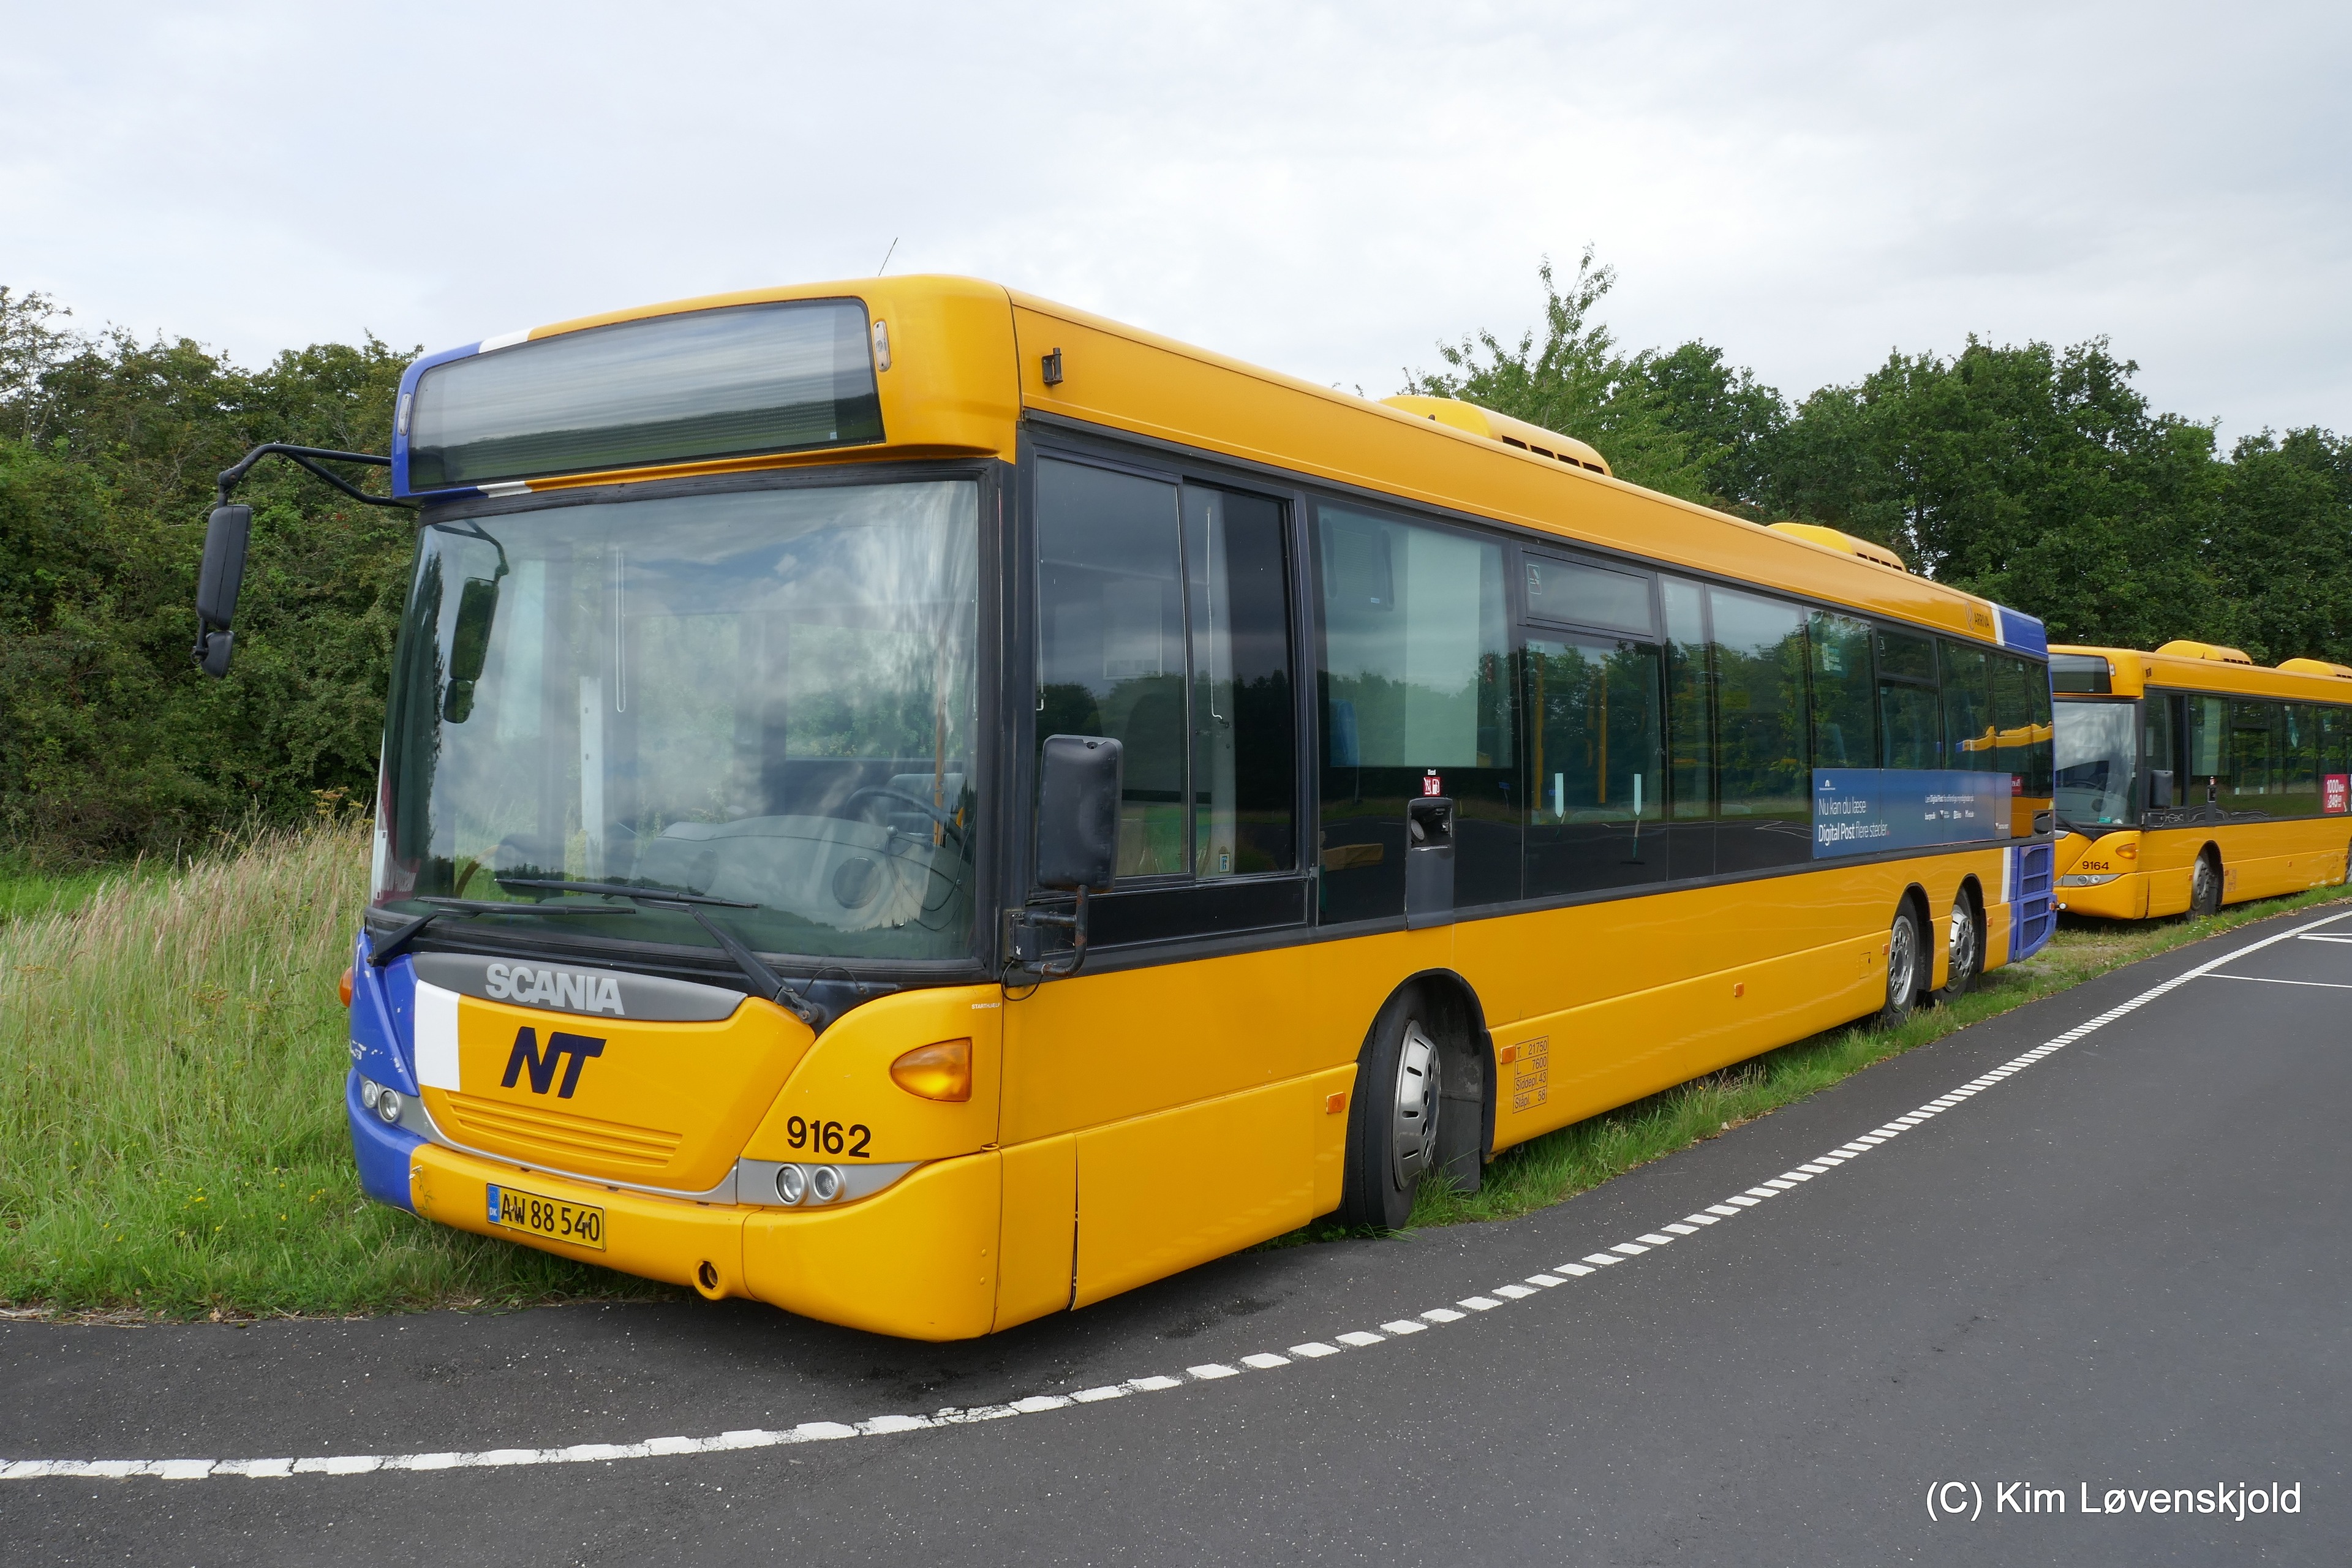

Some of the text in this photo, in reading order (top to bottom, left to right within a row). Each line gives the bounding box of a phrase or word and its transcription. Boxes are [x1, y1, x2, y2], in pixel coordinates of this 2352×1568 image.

[1819, 796, 1866, 815] Nu kan du læse
[1818, 822, 1839, 846] Digital
[1841, 823, 1855, 840] Post
[1855, 821, 1869, 839] flere
[2082, 861, 2109, 871] 9164
[485, 963, 625, 1016] SCANIA
[1517, 1040, 1547, 1058] T. 21750
[500, 1026, 607, 1099] NT
[1517, 1056, 1547, 1075] L. 7600
[1515, 1072, 1547, 1091] Siddepl. 43
[1515, 1089, 1546, 1109] Ståpl. 58
[786, 1115, 872, 1158] 9162
[489, 1207, 498, 1217] DK
[501, 1193, 600, 1242] AW 88 540
